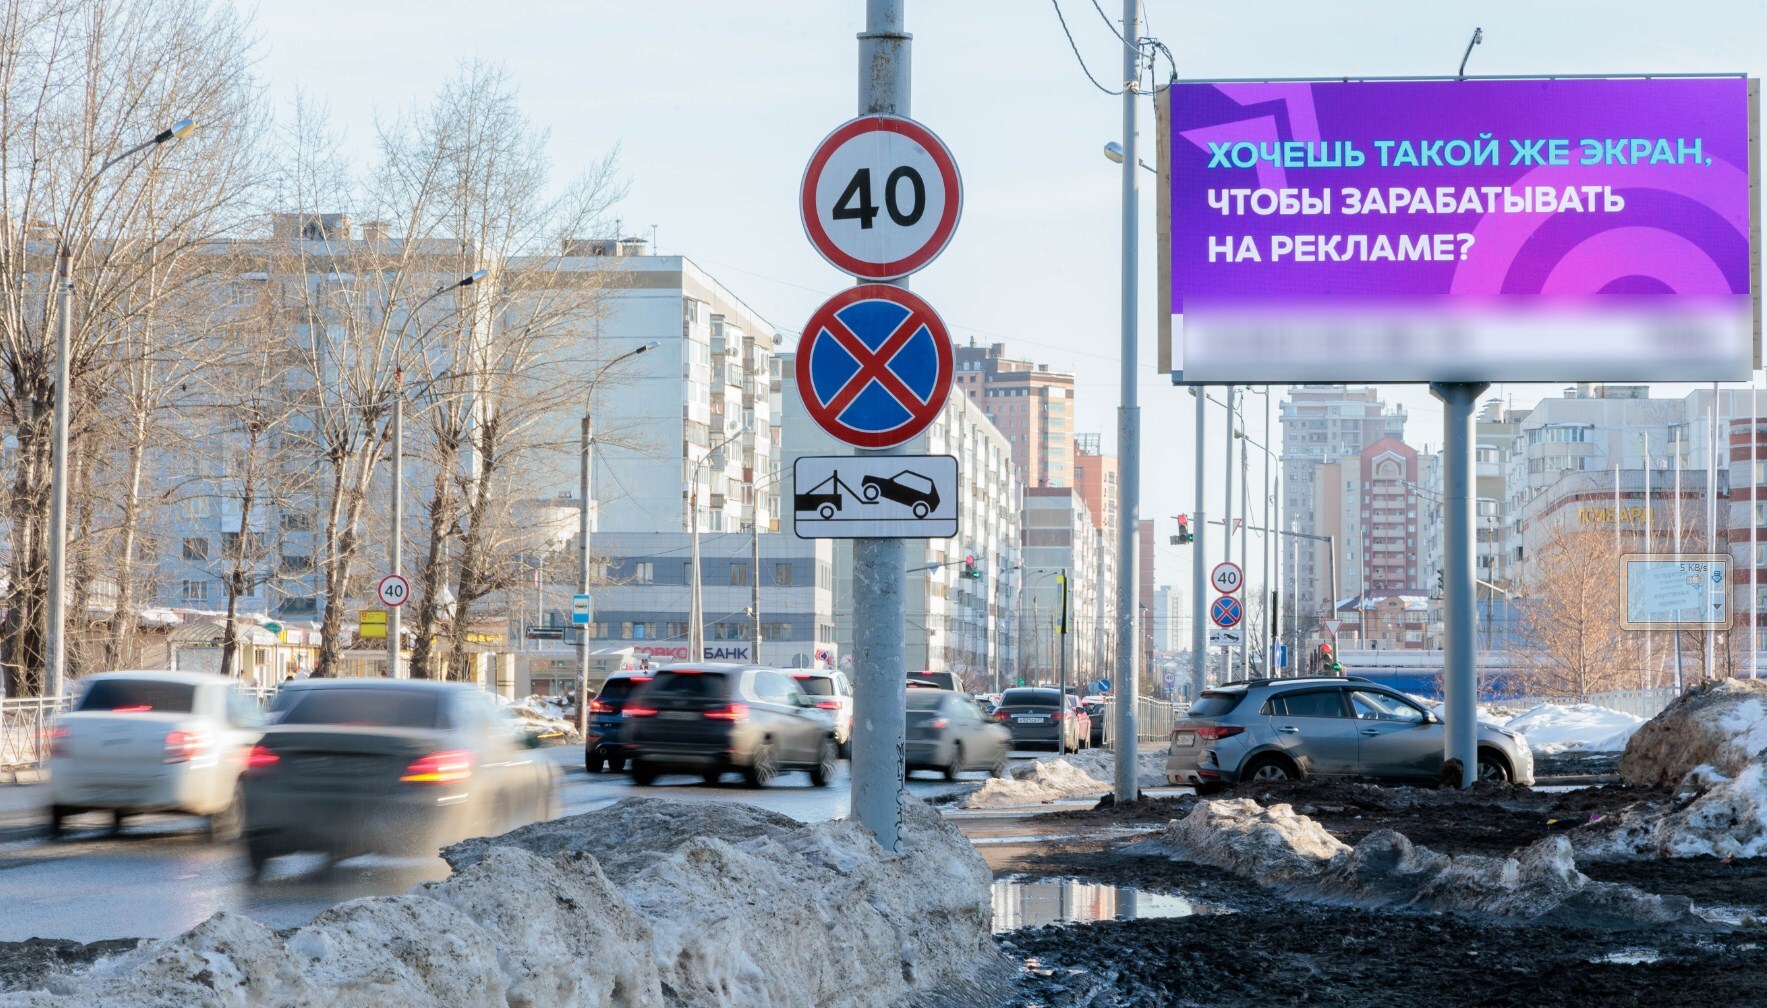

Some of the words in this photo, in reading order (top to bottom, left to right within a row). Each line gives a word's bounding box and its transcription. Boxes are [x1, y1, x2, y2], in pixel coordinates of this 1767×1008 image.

[1207, 139, 1366, 170] ХОЧЕШЬ
[1373, 133, 1499, 167] ТАКОЙ
[1509, 138, 1569, 167] ЖЕ
[1579, 137, 1714, 168] ЭКРАН,
[832, 165, 926, 229] 40
[1208, 188, 1331, 216] ЧТОБЫ
[1341, 185, 1625, 215] ЗАРАБАТЫВАТЬ
[1208, 235, 1262, 263] НА
[1271, 233, 1475, 263] РЕКЛАМЕ?
[384, 584, 404, 598] 40
[1217, 571, 1237, 585] 40
